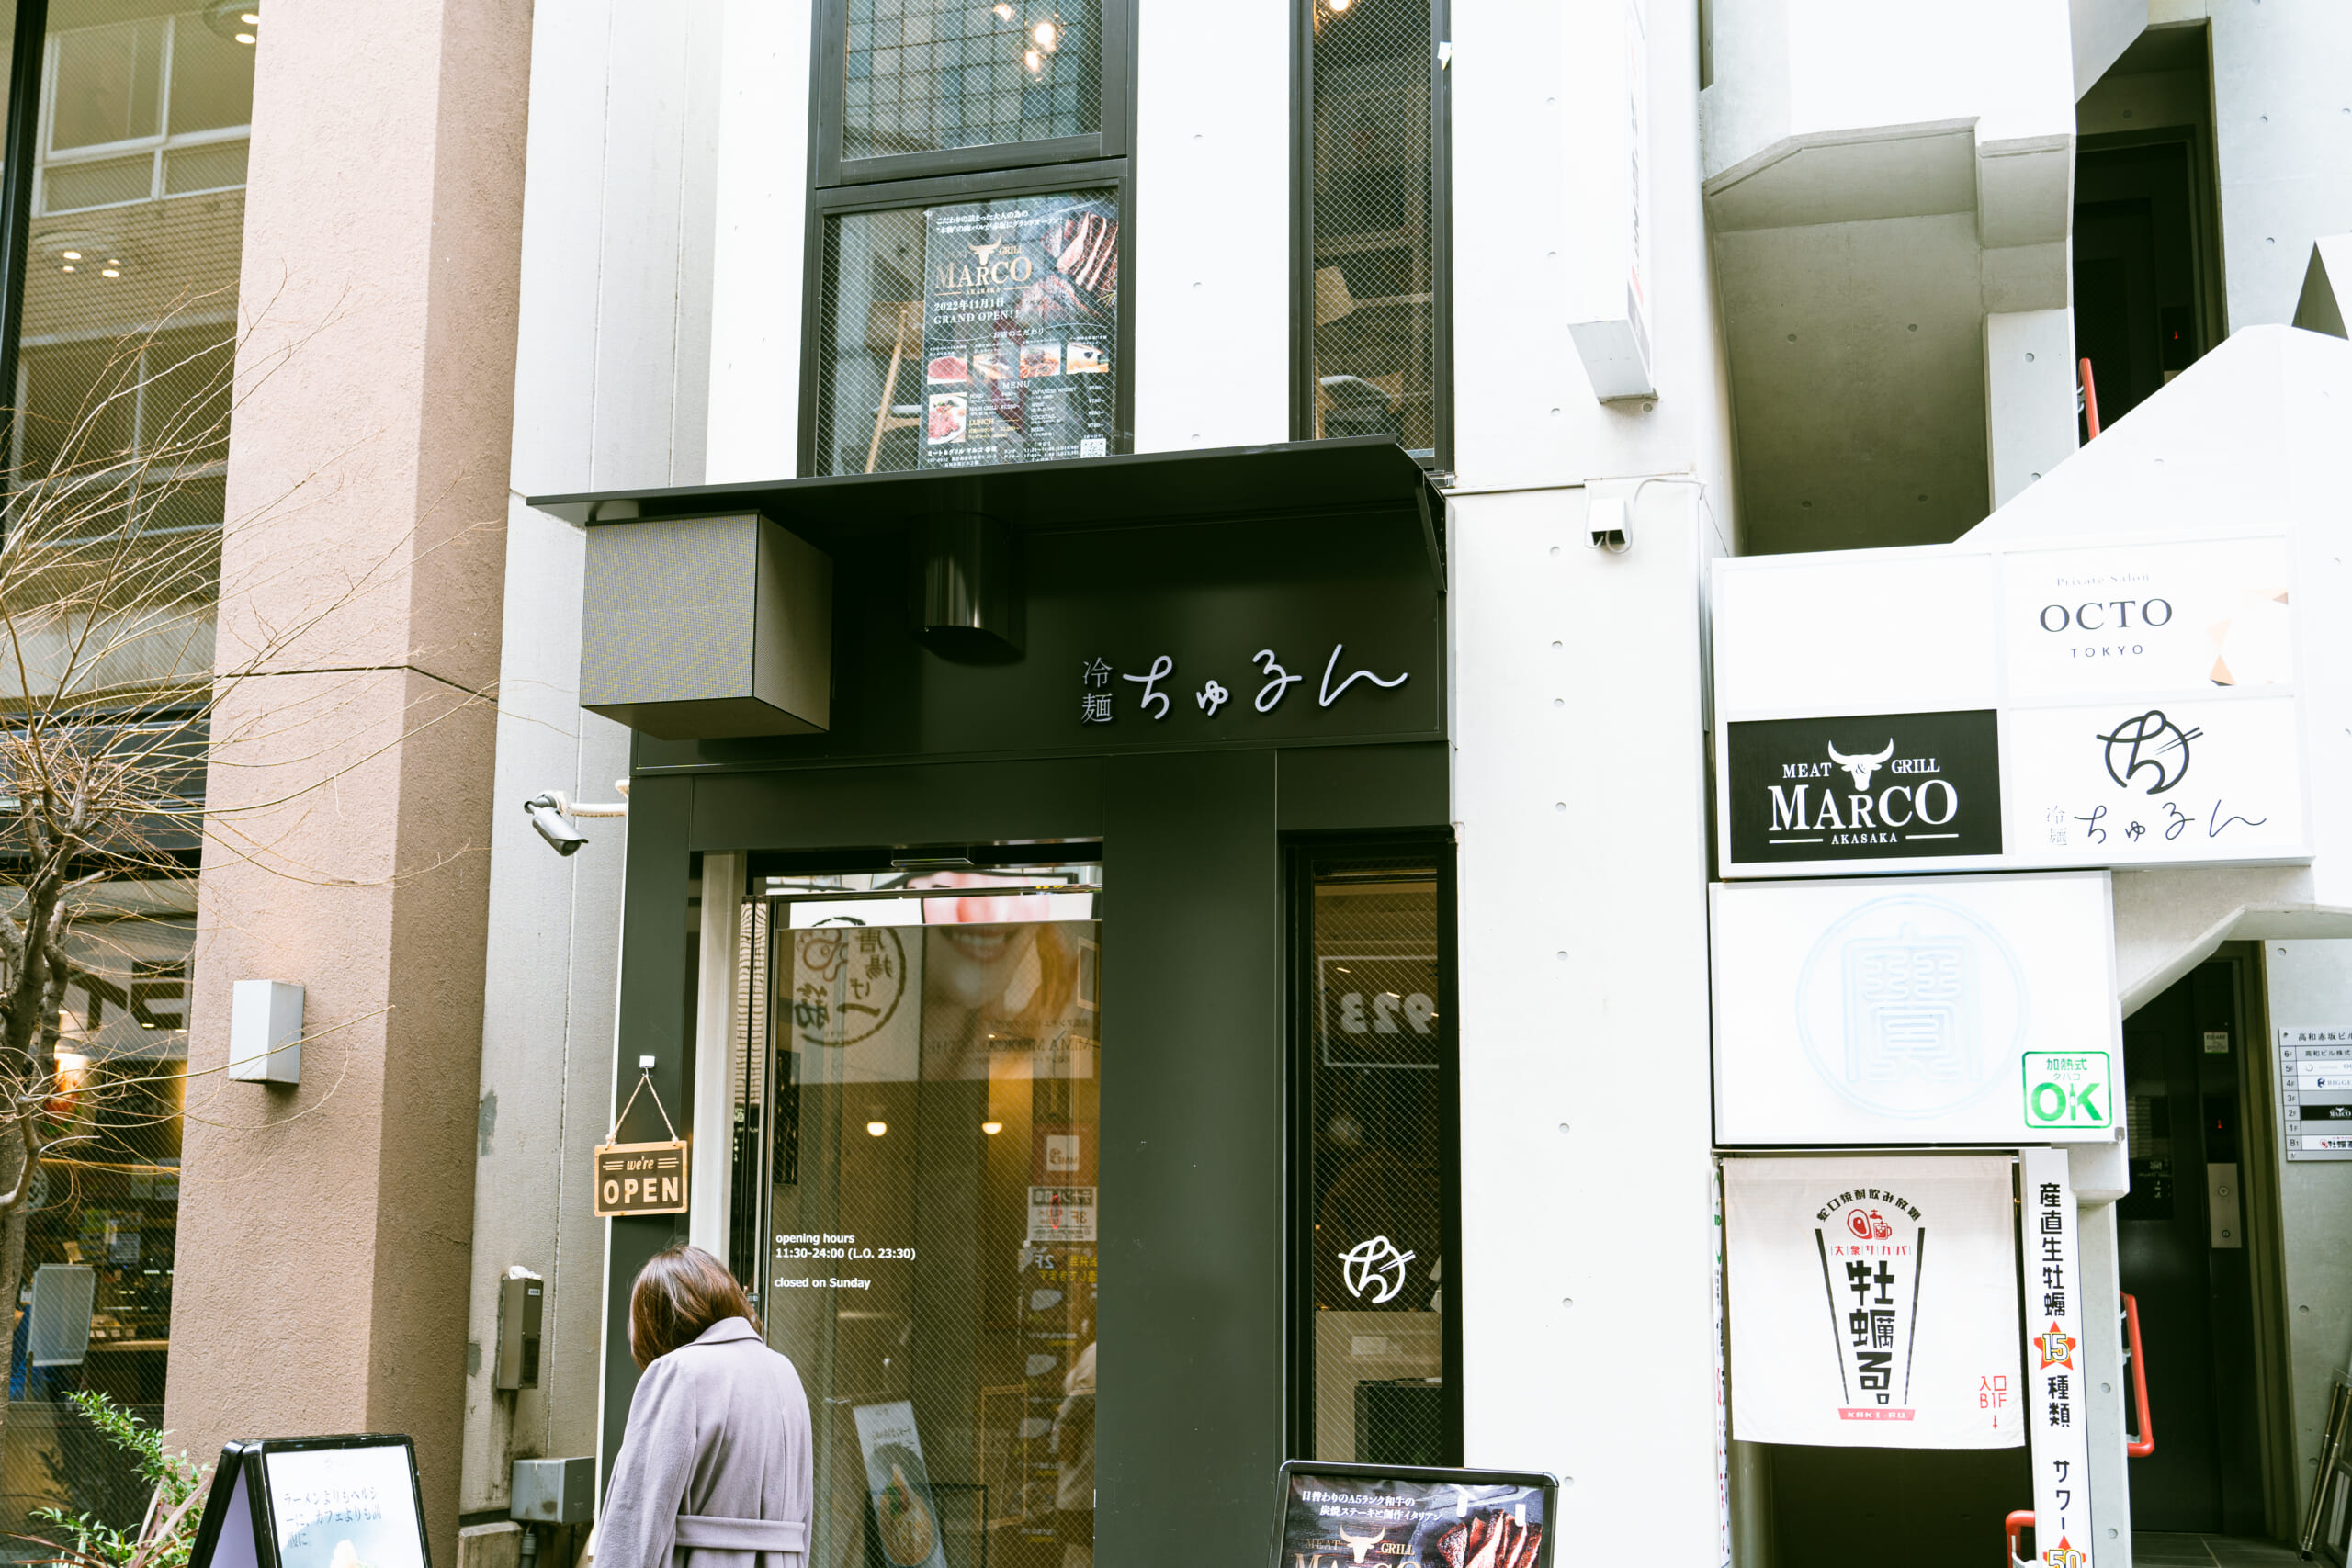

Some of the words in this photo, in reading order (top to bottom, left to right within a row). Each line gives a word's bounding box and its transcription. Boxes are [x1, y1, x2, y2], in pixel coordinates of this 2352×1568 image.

[934, 257, 1033, 289] MARCO
[933, 313, 975, 325] GRAND
[1002, 380, 1030, 389] MENU
[2039, 598, 2173, 632] OCTO
[2069, 644, 2143, 659] TOKYO
[1123, 644, 1409, 719] ちゅるん
[1080, 657, 1113, 724] 冷麺
[1782, 762, 1832, 779] MEAT
[1891, 758, 1940, 773] GRILL
[1767, 779, 1959, 831] MARCO
[2074, 799, 2267, 844] ちゅるん
[1831, 832, 1898, 845] AKASAKA
[2284, 1050, 2293, 1058] 6F
[2045, 1057, 2087, 1072] 加熱式
[2285, 1065, 2294, 1073] 5F
[2286, 1079, 2295, 1088] 4F
[2030, 1081, 2104, 1122] OK
[2287, 1094, 2296, 1102] 3F
[627, 1156, 655, 1171] we're
[603, 1177, 679, 1205] OPEN
[775, 1234, 820, 1247] opening
[823, 1233, 855, 1245] hours
[775, 1247, 845, 1259] 11:30-24:00
[848, 1247, 876, 1260] (L.O.
[878, 1247, 917, 1260] 23:30)
[1834, 1245, 1909, 1257] 大衆サカバ
[2039, 1181, 2066, 1317] 産直生牡蠣
[775, 1277, 814, 1289] closed
[817, 1280, 827, 1289] on
[830, 1277, 871, 1292] Sunday
[2042, 1332, 2069, 1362] 15
[1979, 1375, 2007, 1392] 入口
[1979, 1393, 2007, 1408] B1F
[2047, 1374, 2071, 1428] 種類
[1302, 1490, 1415, 1507] 日替わりのA5ランク和牛の
[2052, 1460, 2072, 1531] サワー
[1319, 1505, 1443, 1522] 炭焼ステーキと創作イタリアン
[1306, 1538, 1341, 1551] MEAT
[1381, 1543, 1416, 1556] GRILL
[2047, 1549, 2084, 1568] 50
